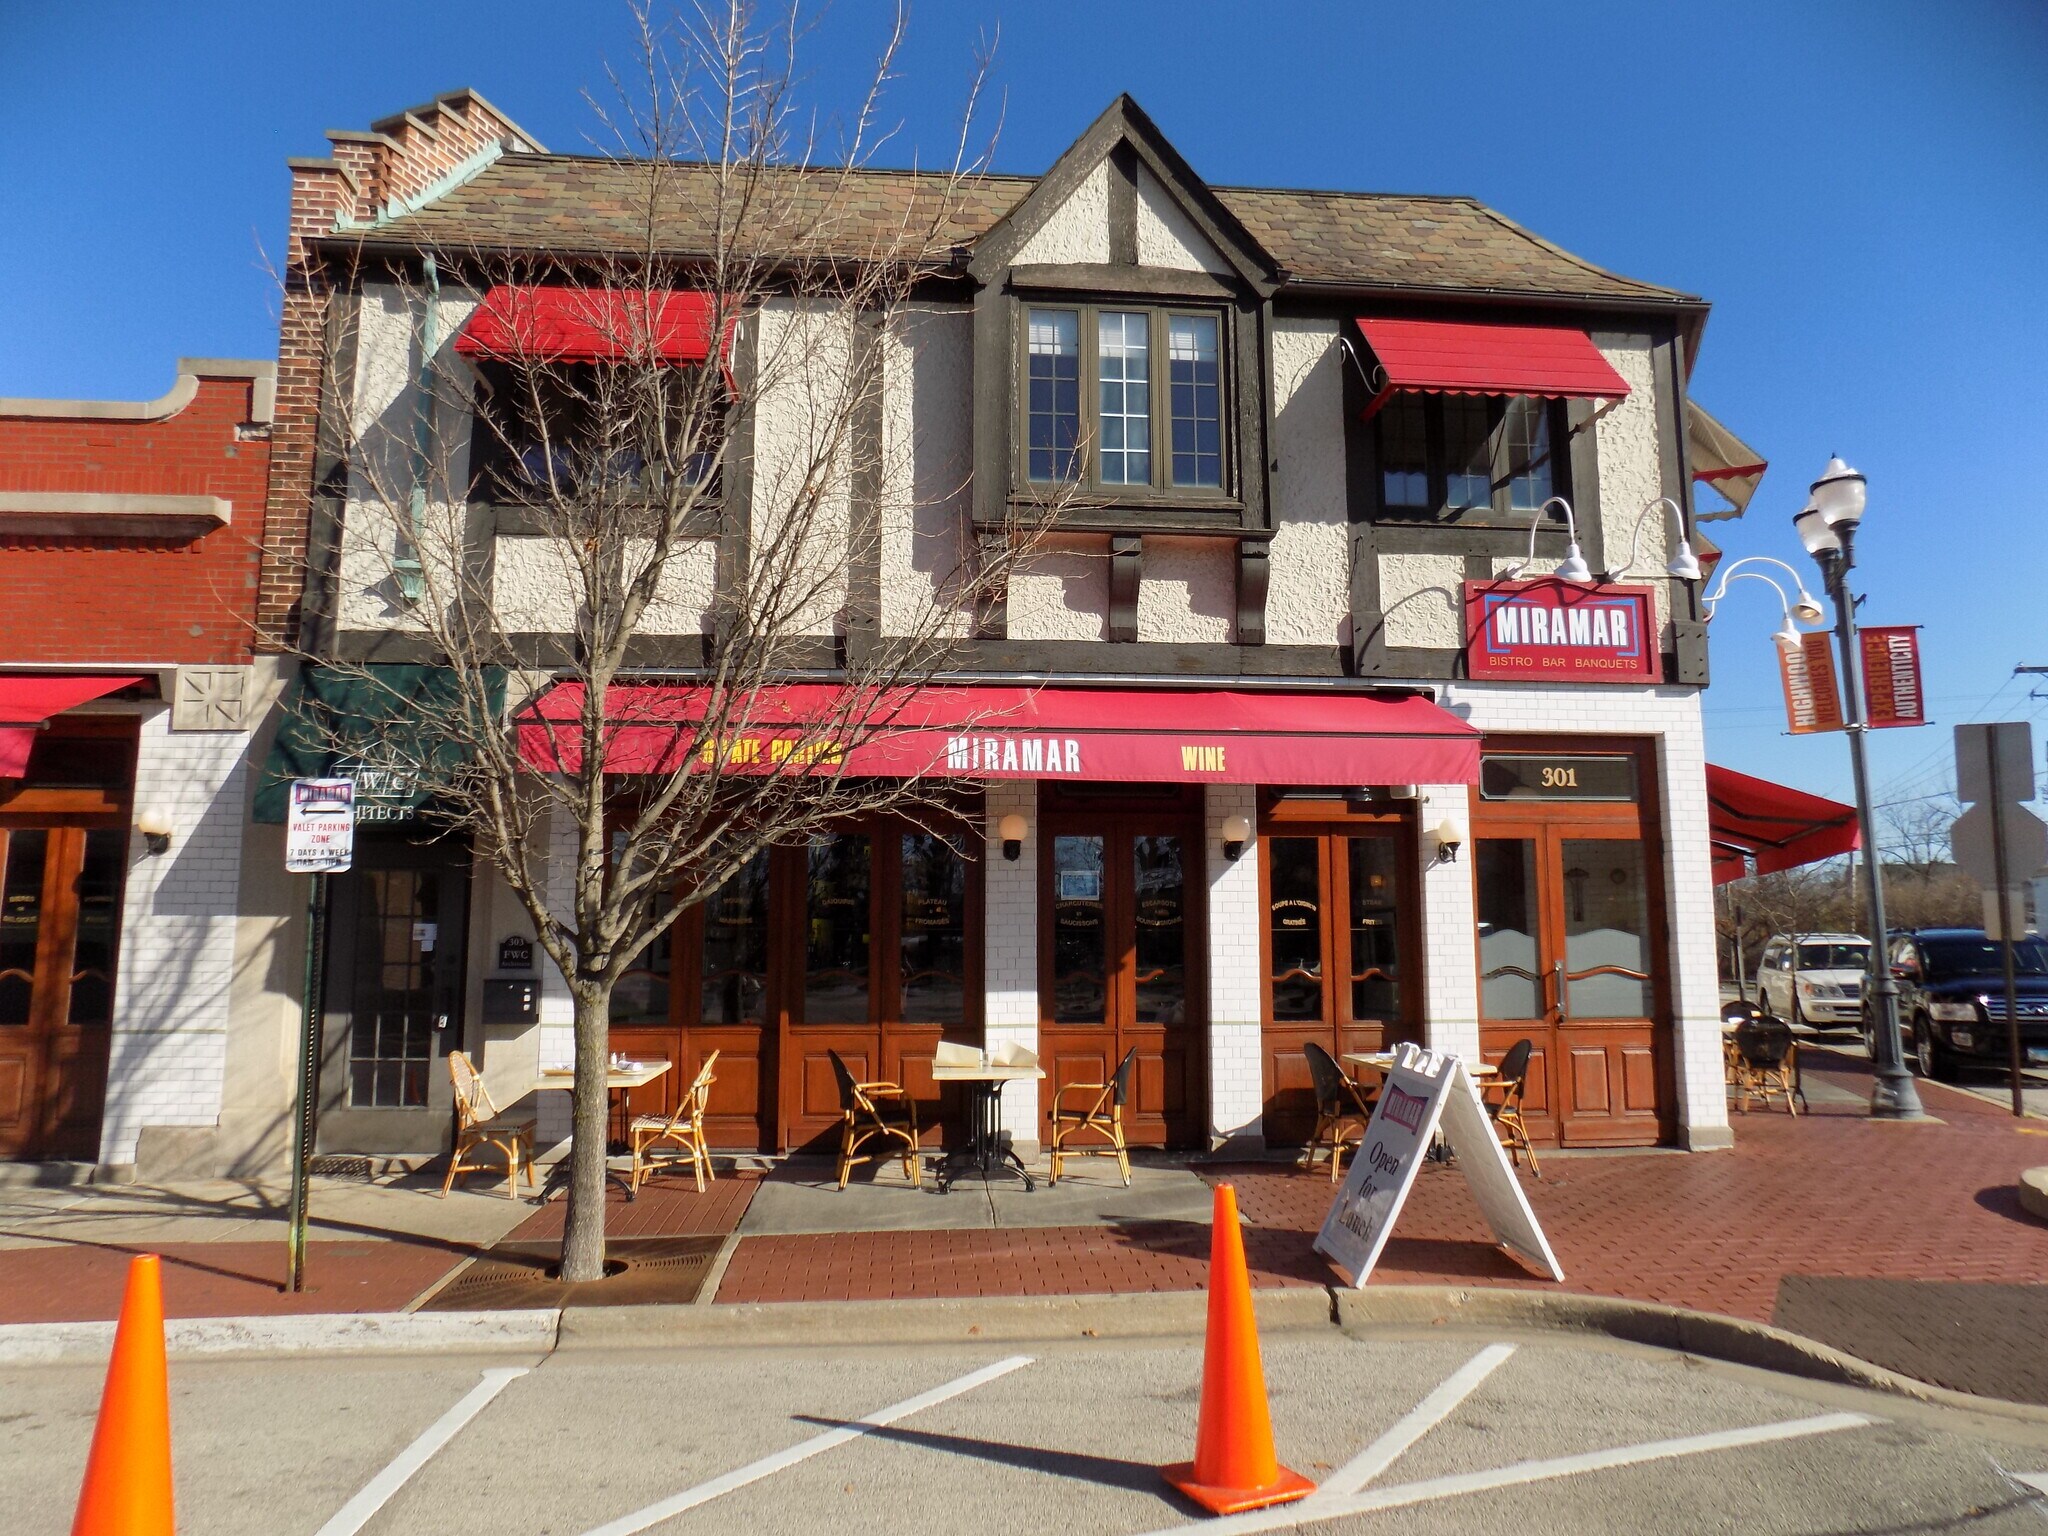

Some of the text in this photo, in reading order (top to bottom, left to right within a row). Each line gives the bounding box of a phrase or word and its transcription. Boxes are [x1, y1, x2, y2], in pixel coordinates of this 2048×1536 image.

[1496, 606, 1629, 647] MIRAMAR
[1489, 656, 1638, 670] BISTRO BAR BANQUETS
[1806, 640, 1825, 662] YOU
[1785, 649, 1816, 727] HIGHWOO
[1866, 635, 1894, 721] EXPERIENCE
[1888, 635, 1918, 718] AUTHENTICITY
[946, 736, 1081, 773] MIRAMAR
[1181, 746, 1226, 772] WINE
[1541, 767, 1578, 787] 301
[293, 823, 350, 832] VALET PARKING
[311, 834, 331, 844] ZONE
[290, 849, 294, 857] 7
[298, 849, 317, 857] DAYS
[328, 848, 350, 856] WEEK
[503, 950, 529, 960] FWC
[509, 938, 524, 946] 303
[1369, 1141, 1400, 1176] Open
[1358, 1174, 1378, 1201] for
[1338, 1200, 1373, 1242] Lunch
